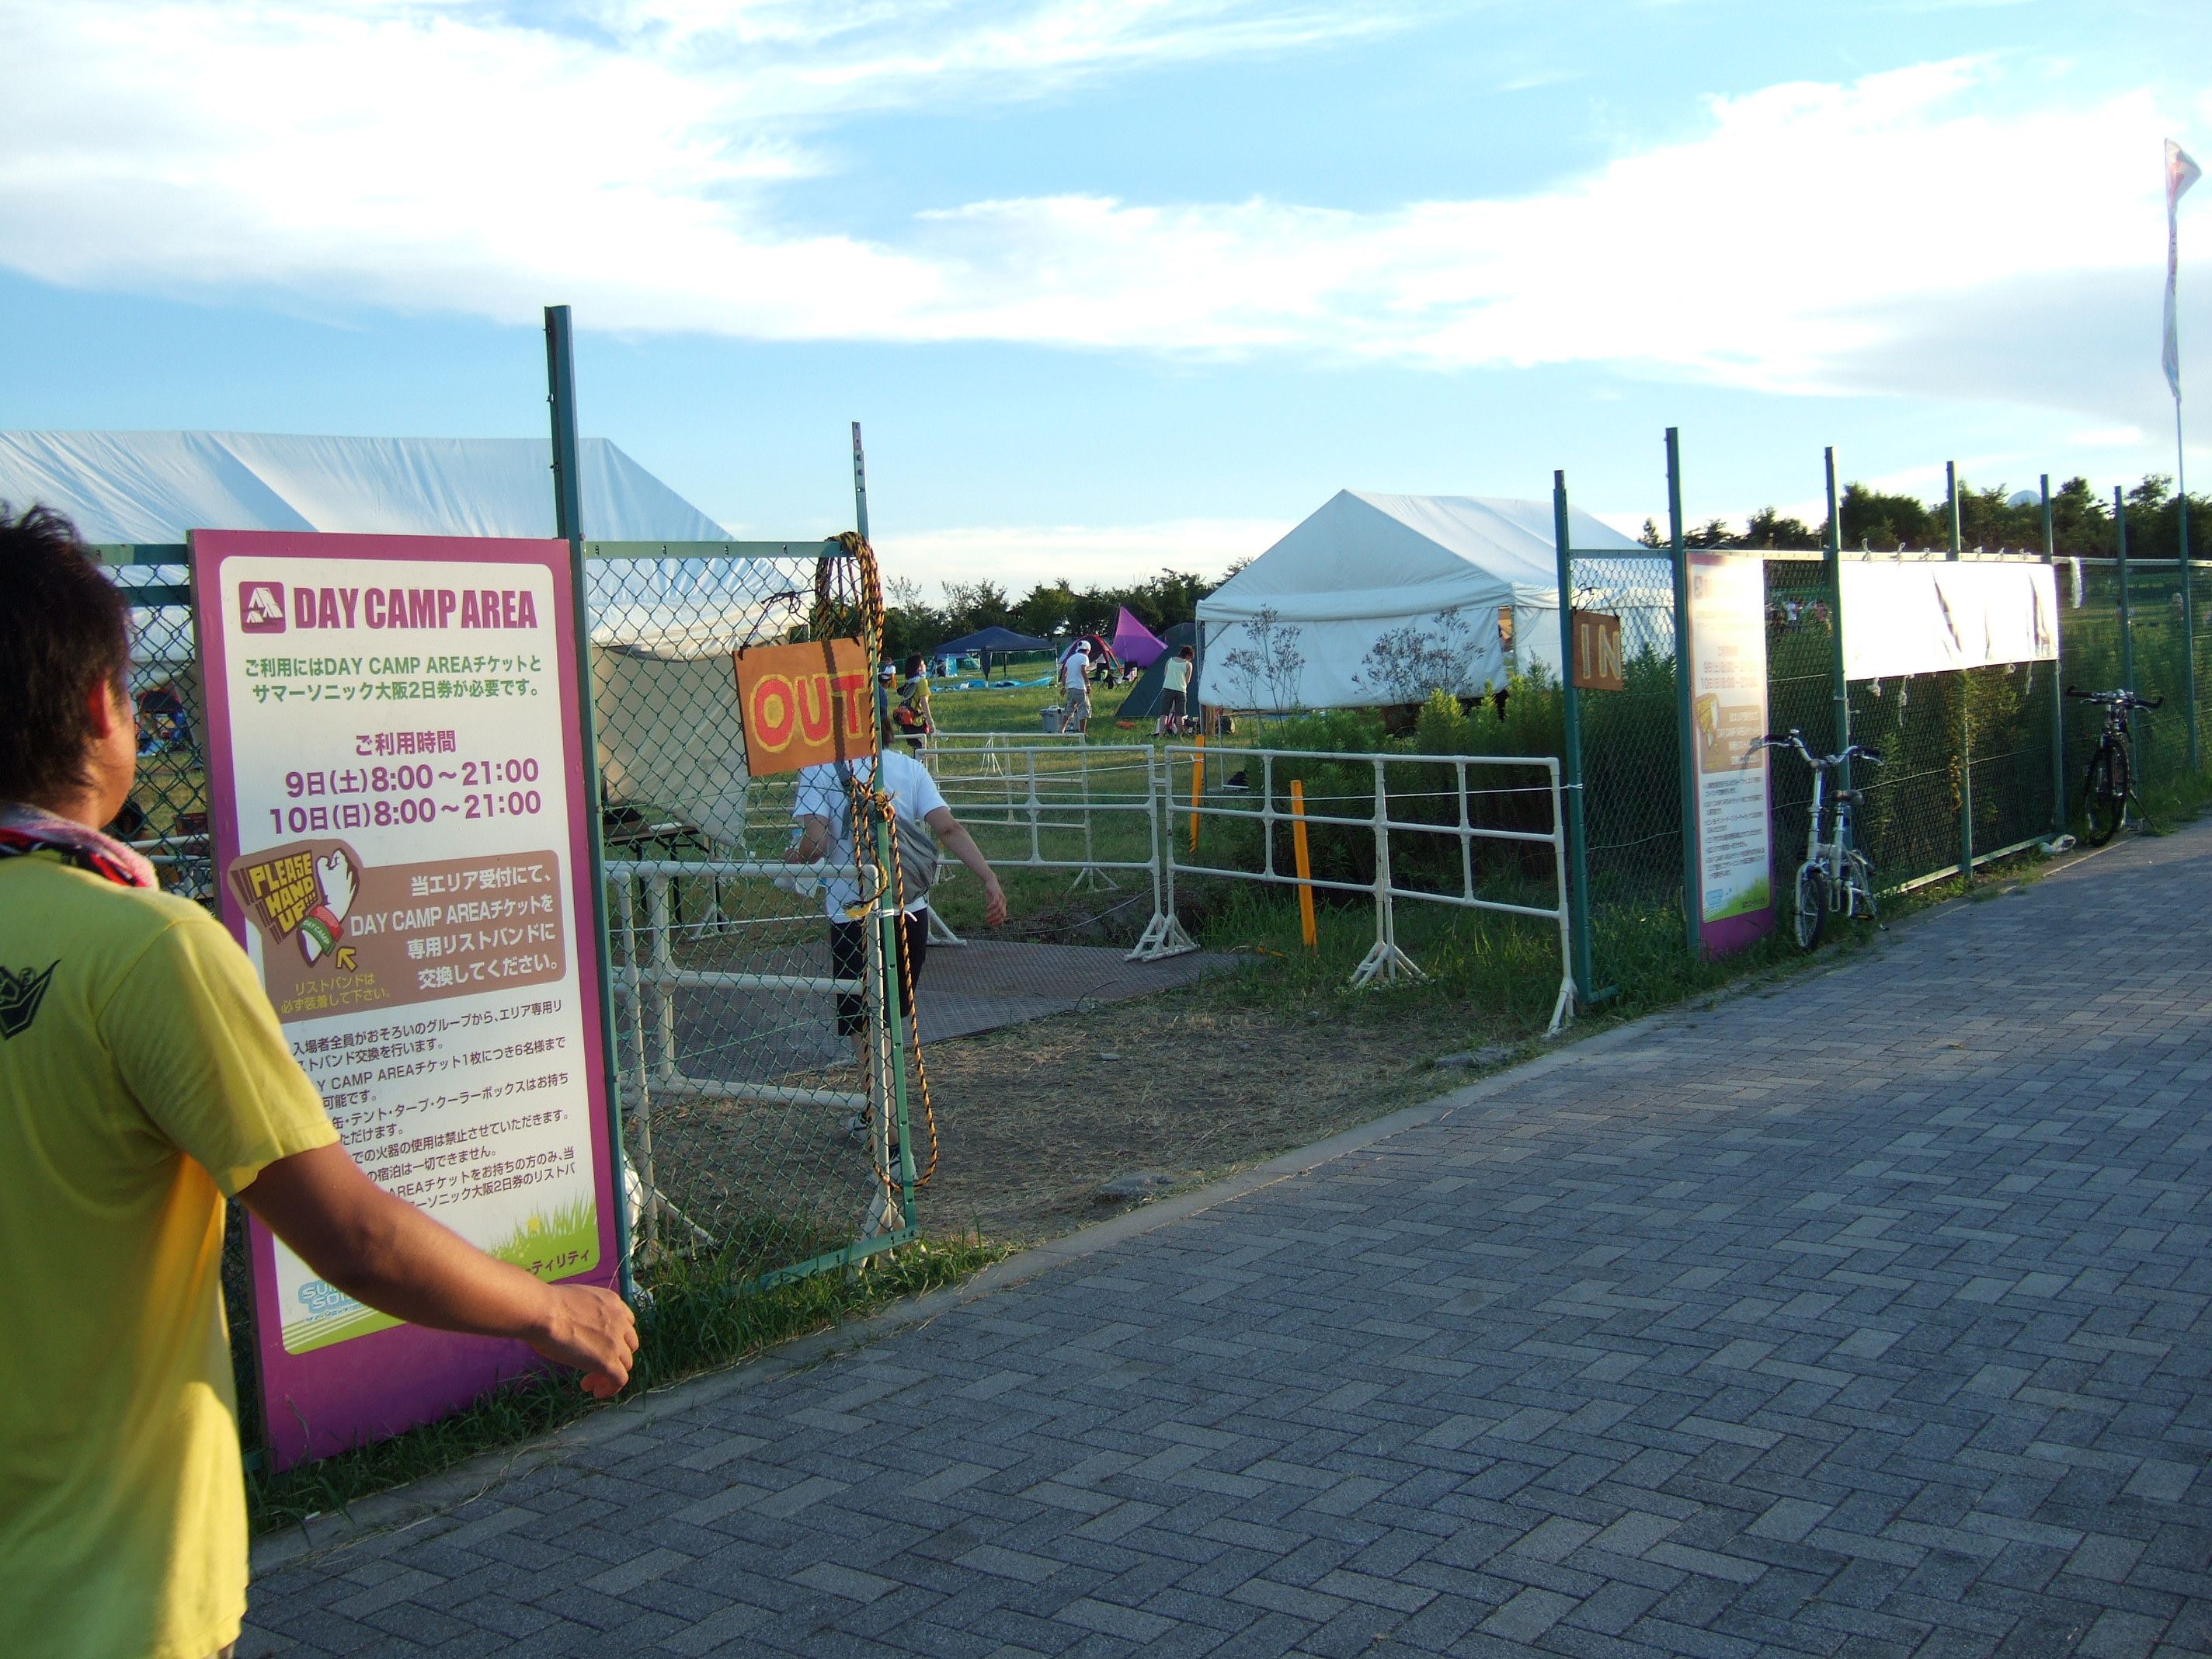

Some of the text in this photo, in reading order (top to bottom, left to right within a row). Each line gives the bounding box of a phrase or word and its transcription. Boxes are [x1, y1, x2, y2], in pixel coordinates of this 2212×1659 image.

[294, 587, 538, 630] DAY CAMP AREA
[245, 655, 541, 678] ご利用にはDAY CAMP AREAチケットと
[1581, 624, 1622, 681] IN
[252, 678, 537, 704] サマーソニック大阪2日券が必要です。
[750, 671, 868, 753] OUT
[354, 729, 457, 757] ご利用時間
[249, 853, 312, 899] PLEASE
[412, 863, 551, 897] 当エリア受付にて、
[265, 875, 315, 918] HAND
[351, 894, 554, 937] DAY CAMP AREAチケットを
[407, 923, 556, 961] 専用リストバンドに
[295, 972, 376, 996] リストバンドは
[418, 953, 559, 991] 交換してください。
[332, 1071, 373, 1090] CAMP
[350, 1109, 569, 1164] での火器の使用は禁止させていただきます。
[410, 1161, 576, 1209] ーソニック大阪2日券のリストバ
